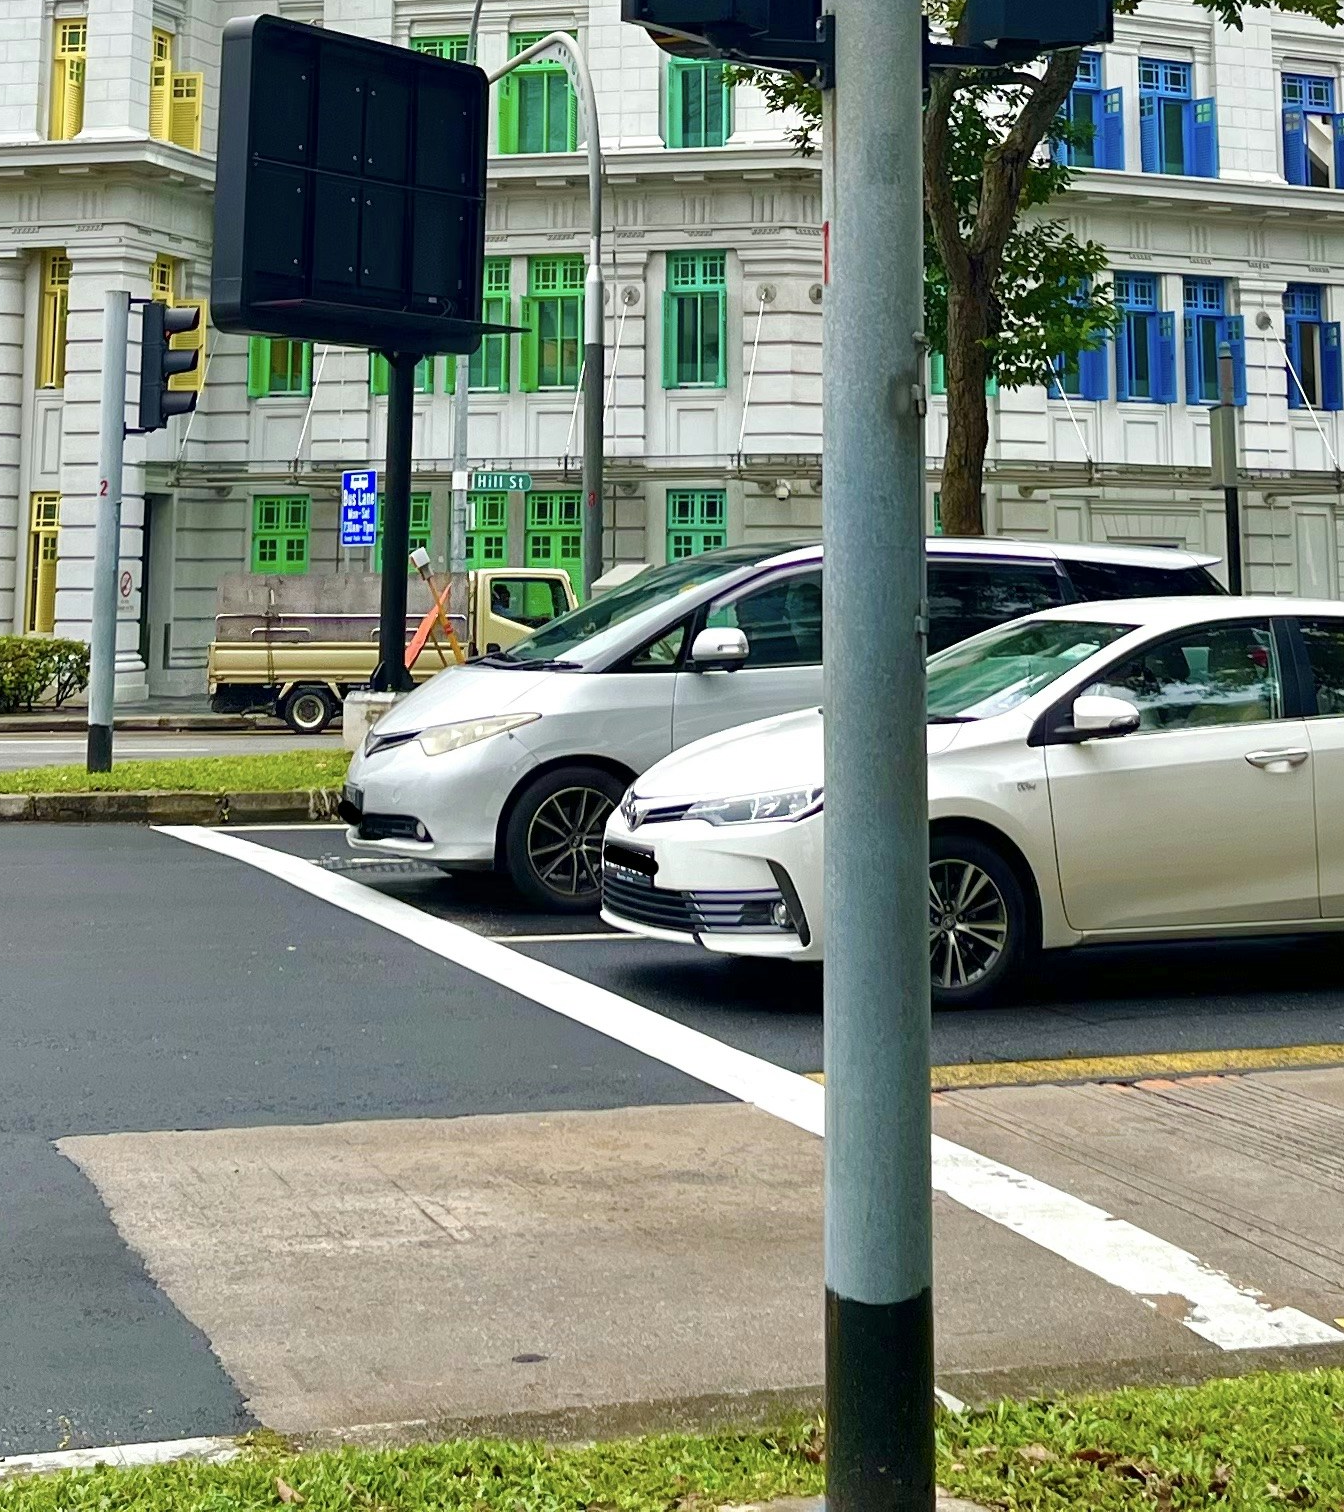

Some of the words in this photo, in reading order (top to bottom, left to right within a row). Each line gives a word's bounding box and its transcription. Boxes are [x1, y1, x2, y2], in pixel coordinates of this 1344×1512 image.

[100, 480, 109, 496] 2
[478, 474, 503, 488] Hill
[509, 475, 523, 489] St
[343, 489, 356, 507] Bus
[357, 489, 375, 506] Lane
